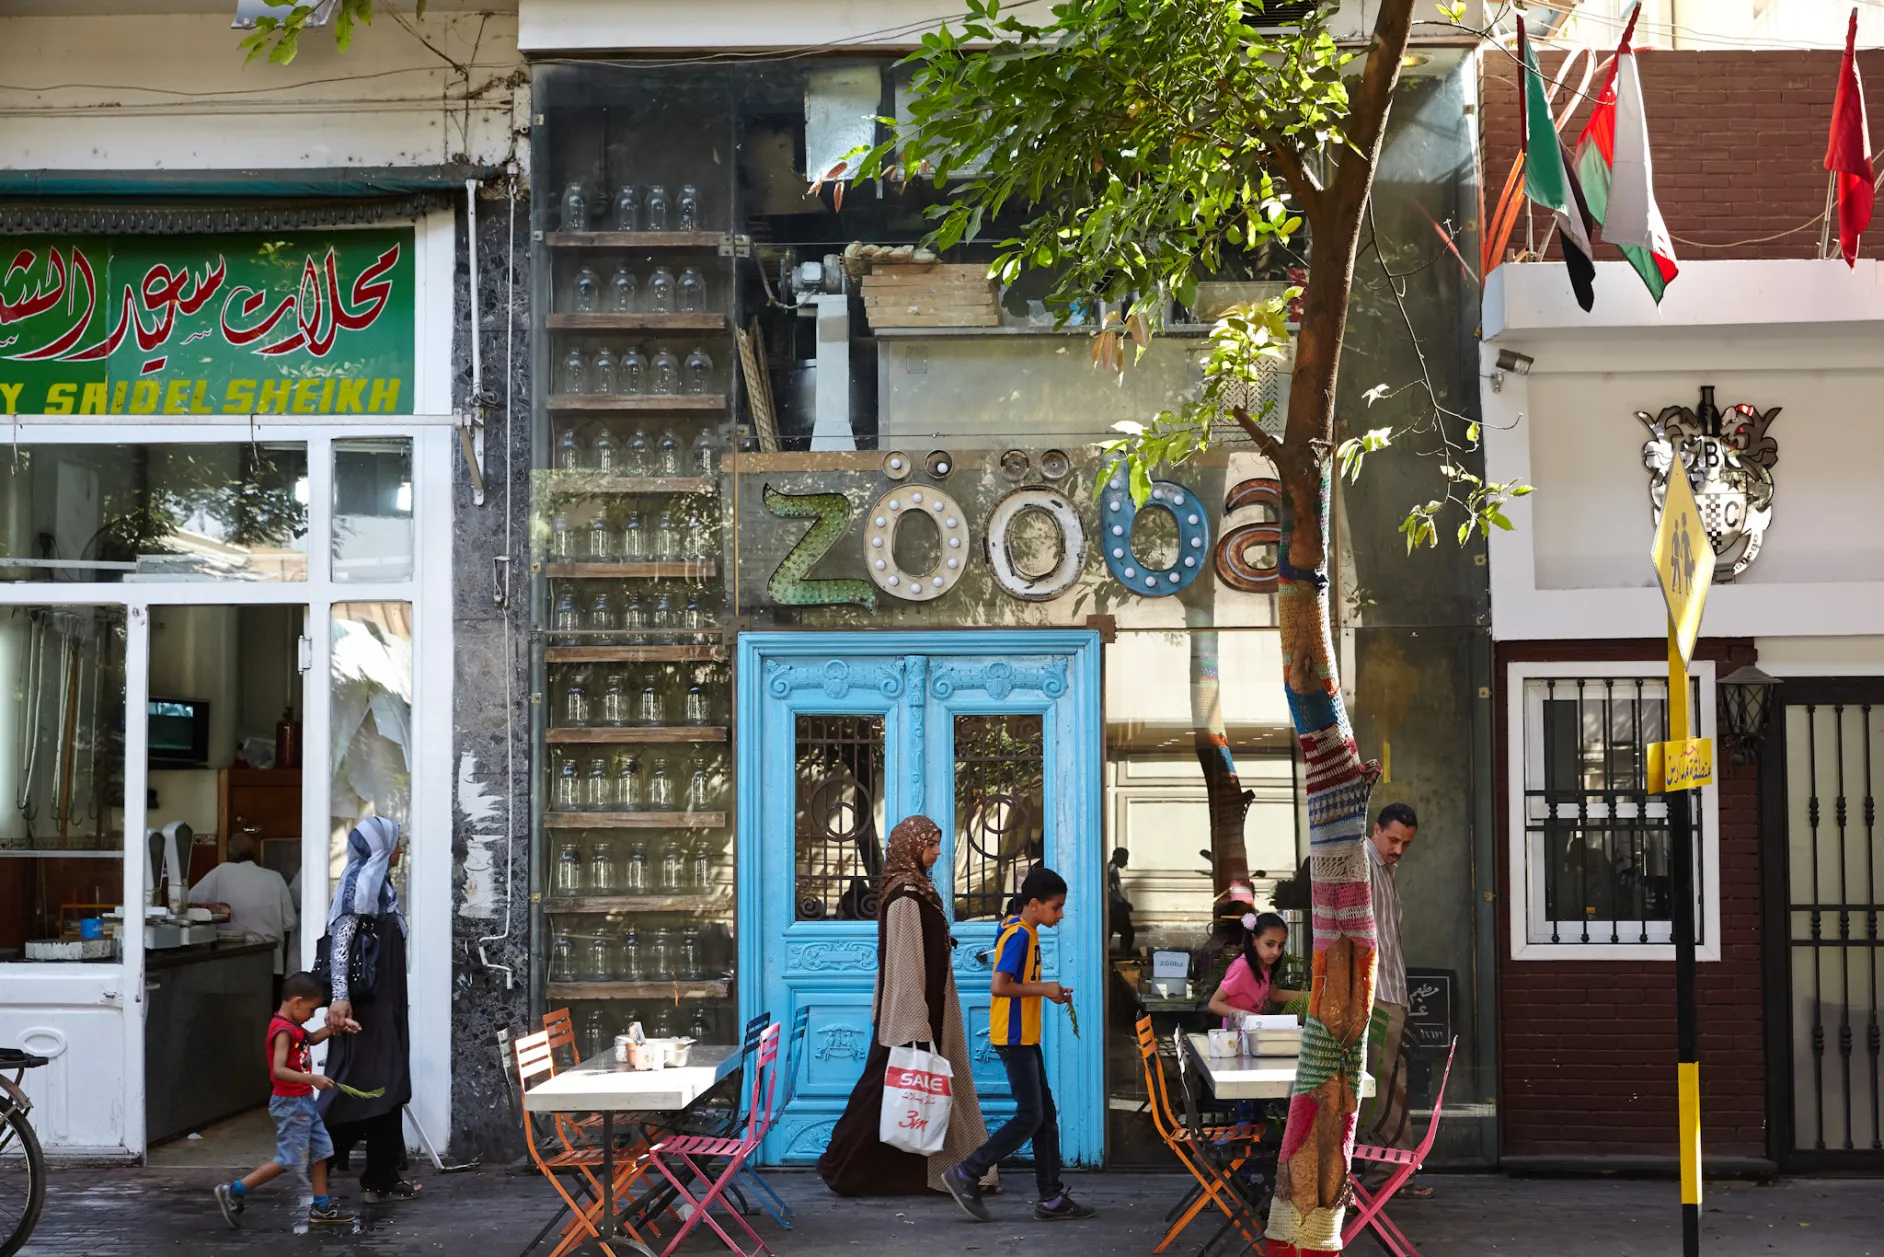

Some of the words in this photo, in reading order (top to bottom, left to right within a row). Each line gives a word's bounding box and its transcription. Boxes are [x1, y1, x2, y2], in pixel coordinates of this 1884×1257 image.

[53, 253, 226, 376] سعيد
[220, 242, 400, 357] محلات
[223, 379, 401, 414] SHEIKH
[899, 1072, 943, 1092] SALE
